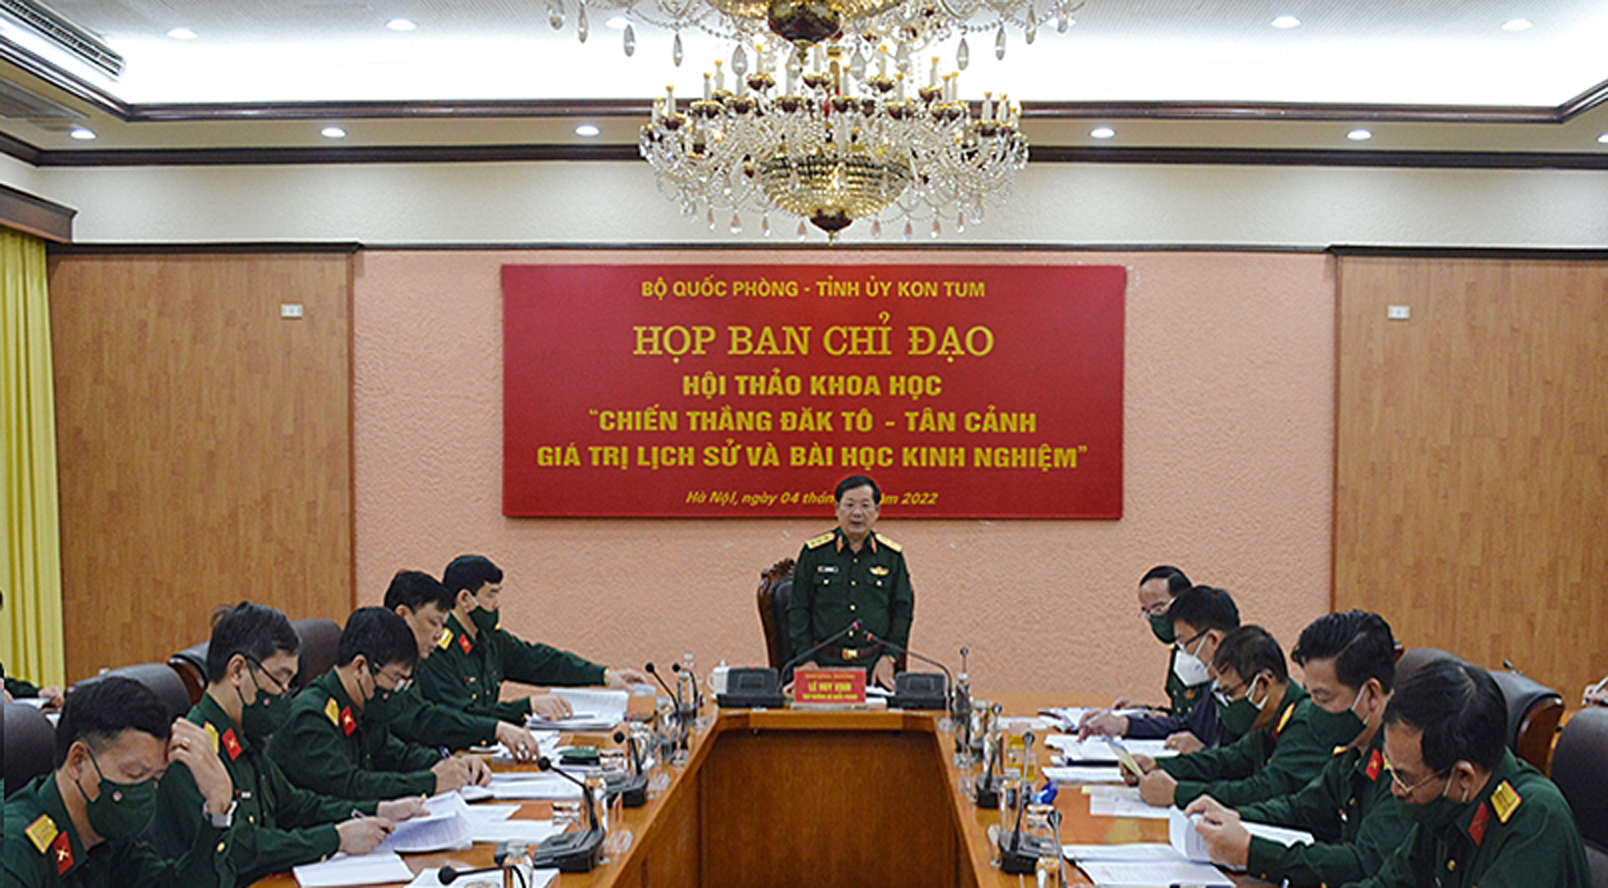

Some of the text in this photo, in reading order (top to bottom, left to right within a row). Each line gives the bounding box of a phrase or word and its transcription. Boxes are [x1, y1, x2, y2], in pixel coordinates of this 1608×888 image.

[641, 276, 668, 300] BỘ
[673, 274, 728, 297] QUỐC
[733, 276, 799, 297] PHÒNG
[816, 275, 860, 297] TỈNH
[866, 275, 893, 297] ỦY
[898, 281, 939, 297] KON
[944, 281, 985, 298] TUM
[633, 311, 994, 363] HỌP BAN CHỈ ĐẠO
[682, 367, 942, 400] HỘI THẢO KHOA HỌC
[779, 407, 833, 432] ĐĂK
[841, 407, 873, 433] TÔ
[904, 407, 956, 433] TÂN
[964, 405, 1037, 433] CẢNH
[537, 442, 581, 467] GIÁ
[588, 446, 629, 470] TRỊ
[637, 446, 695, 470] LỊCH
[703, 438, 742, 467] SỬ
[747, 442, 780, 467] VÀ
[790, 442, 833, 467] BÀI
[841, 446, 894, 471] HỌC
[902, 447, 965, 468] KINH
[685, 491, 707, 504] Hà
[741, 491, 778, 507] ngày
[780, 491, 800, 504] 04
[901, 492, 939, 505] 2022
